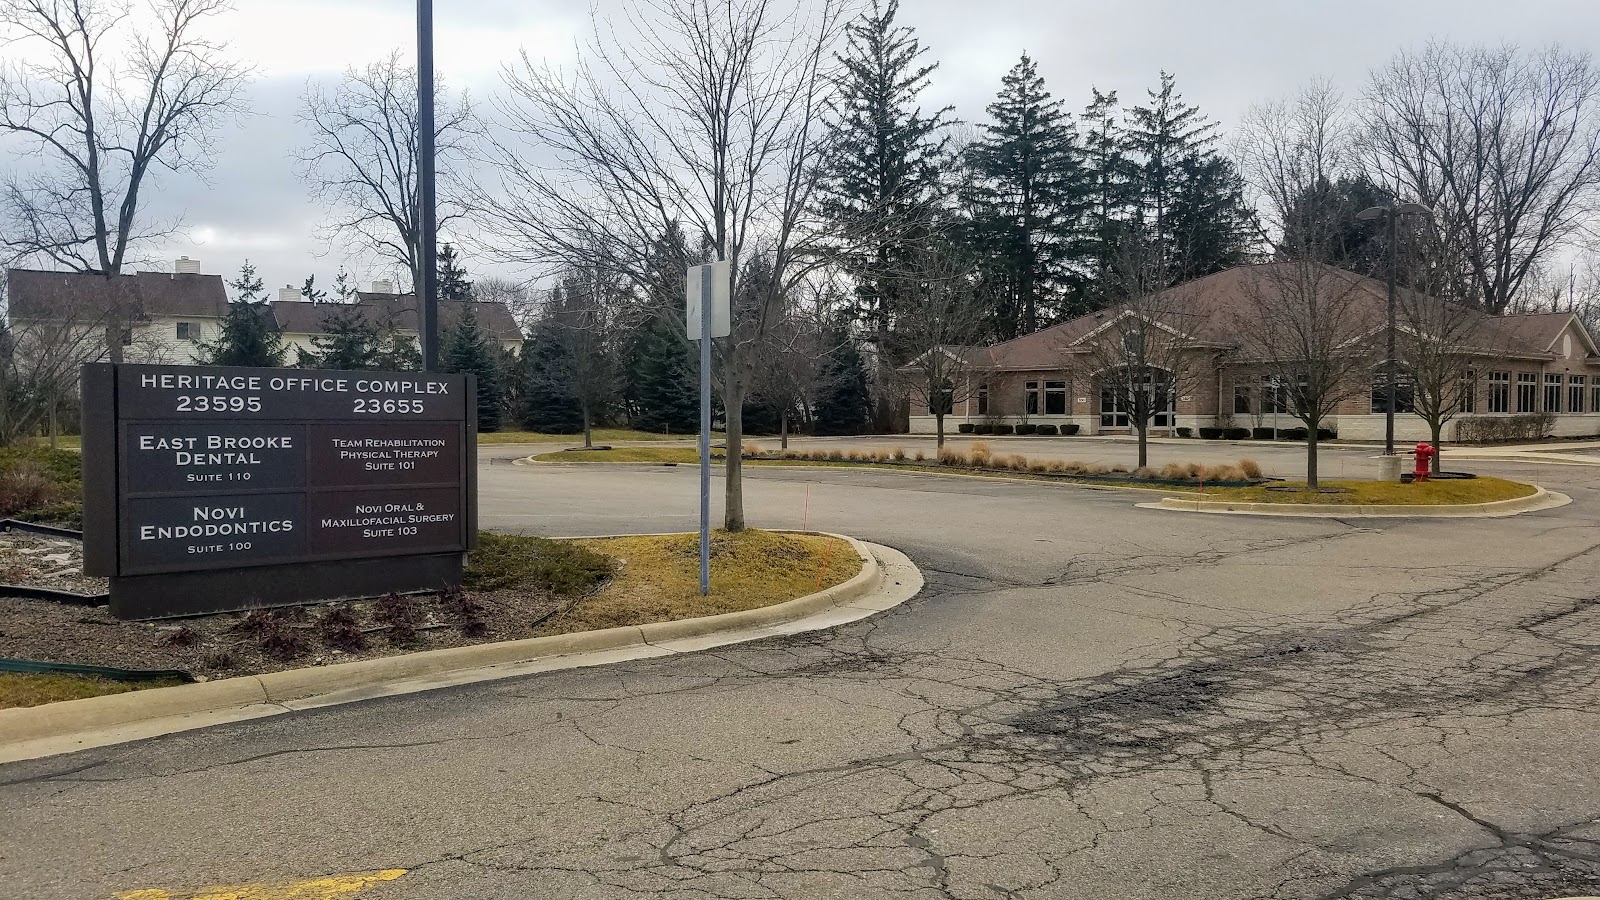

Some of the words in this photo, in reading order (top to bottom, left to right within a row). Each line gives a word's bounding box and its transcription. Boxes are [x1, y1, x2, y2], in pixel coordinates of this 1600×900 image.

[141, 374, 261, 390] HERITAGE
[269, 377, 348, 392] OFFICE
[355, 379, 449, 395] COMPLEX
[176, 395, 262, 413] 23595
[352, 398, 424, 414] 23655
[139, 435, 198, 450] EAST
[207, 435, 293, 449] BROOKE
[332, 438, 363, 448] TEAM
[365, 438, 445, 448] REHABILITATION
[176, 451, 261, 466] DENTAL
[340, 450, 392, 460] PHYSICAL
[393, 449, 439, 459] THERAPY
[365, 461, 395, 471] SUITE
[398, 461, 415, 470] 101
[186, 473, 223, 482] SUITE
[228, 472, 251, 481] 110
[193, 506, 244, 521] NOVI
[355, 504, 382, 514] NOVI
[384, 503, 414, 513] ORAL
[415, 502, 425, 511] &
[321, 516, 407, 528] MAXILLOFACIAL
[408, 513, 455, 524] SURGERY
[140, 519, 293, 541] ENDODONTICS
[363, 528, 394, 538] SUITE
[397, 526, 418, 536] 103
[187, 544, 223, 554] SUITE
[229, 541, 252, 551] 100
